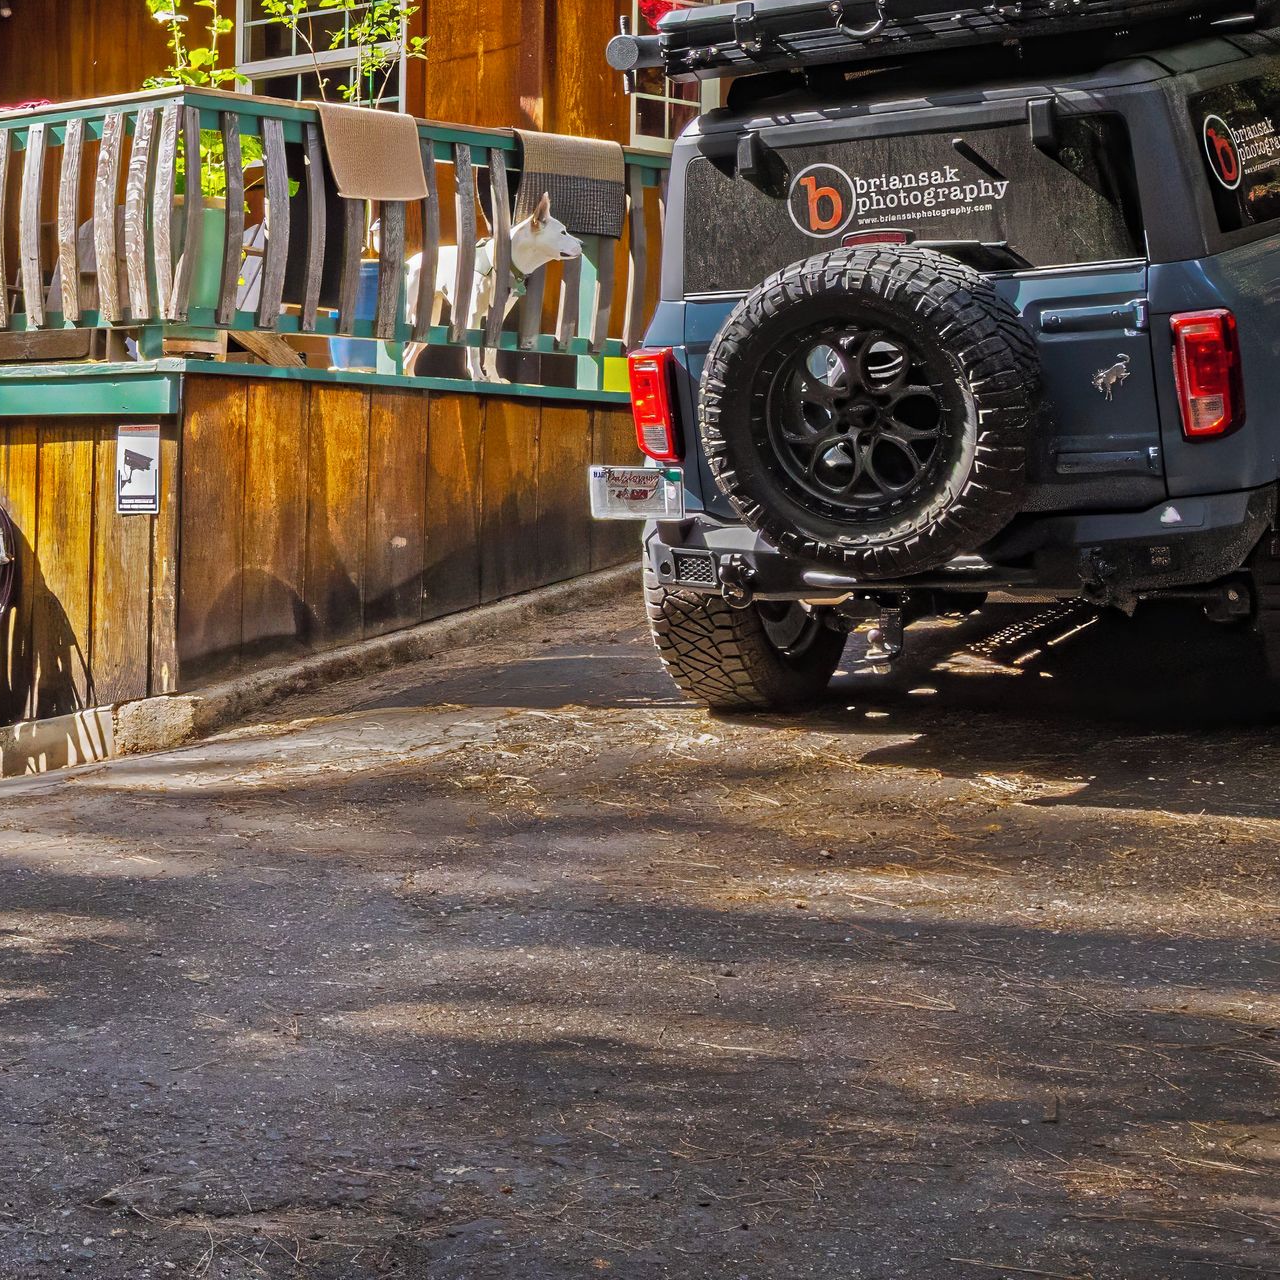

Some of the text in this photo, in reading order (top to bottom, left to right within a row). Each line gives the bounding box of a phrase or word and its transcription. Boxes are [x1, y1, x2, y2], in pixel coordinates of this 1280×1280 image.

[1230, 116, 1275, 144] briansak
[1237, 135, 1280, 165] photogra
[854, 165, 960, 194] briansak
[856, 179, 1009, 215] photography
[857, 203, 993, 225] www.briansakphotography.com
